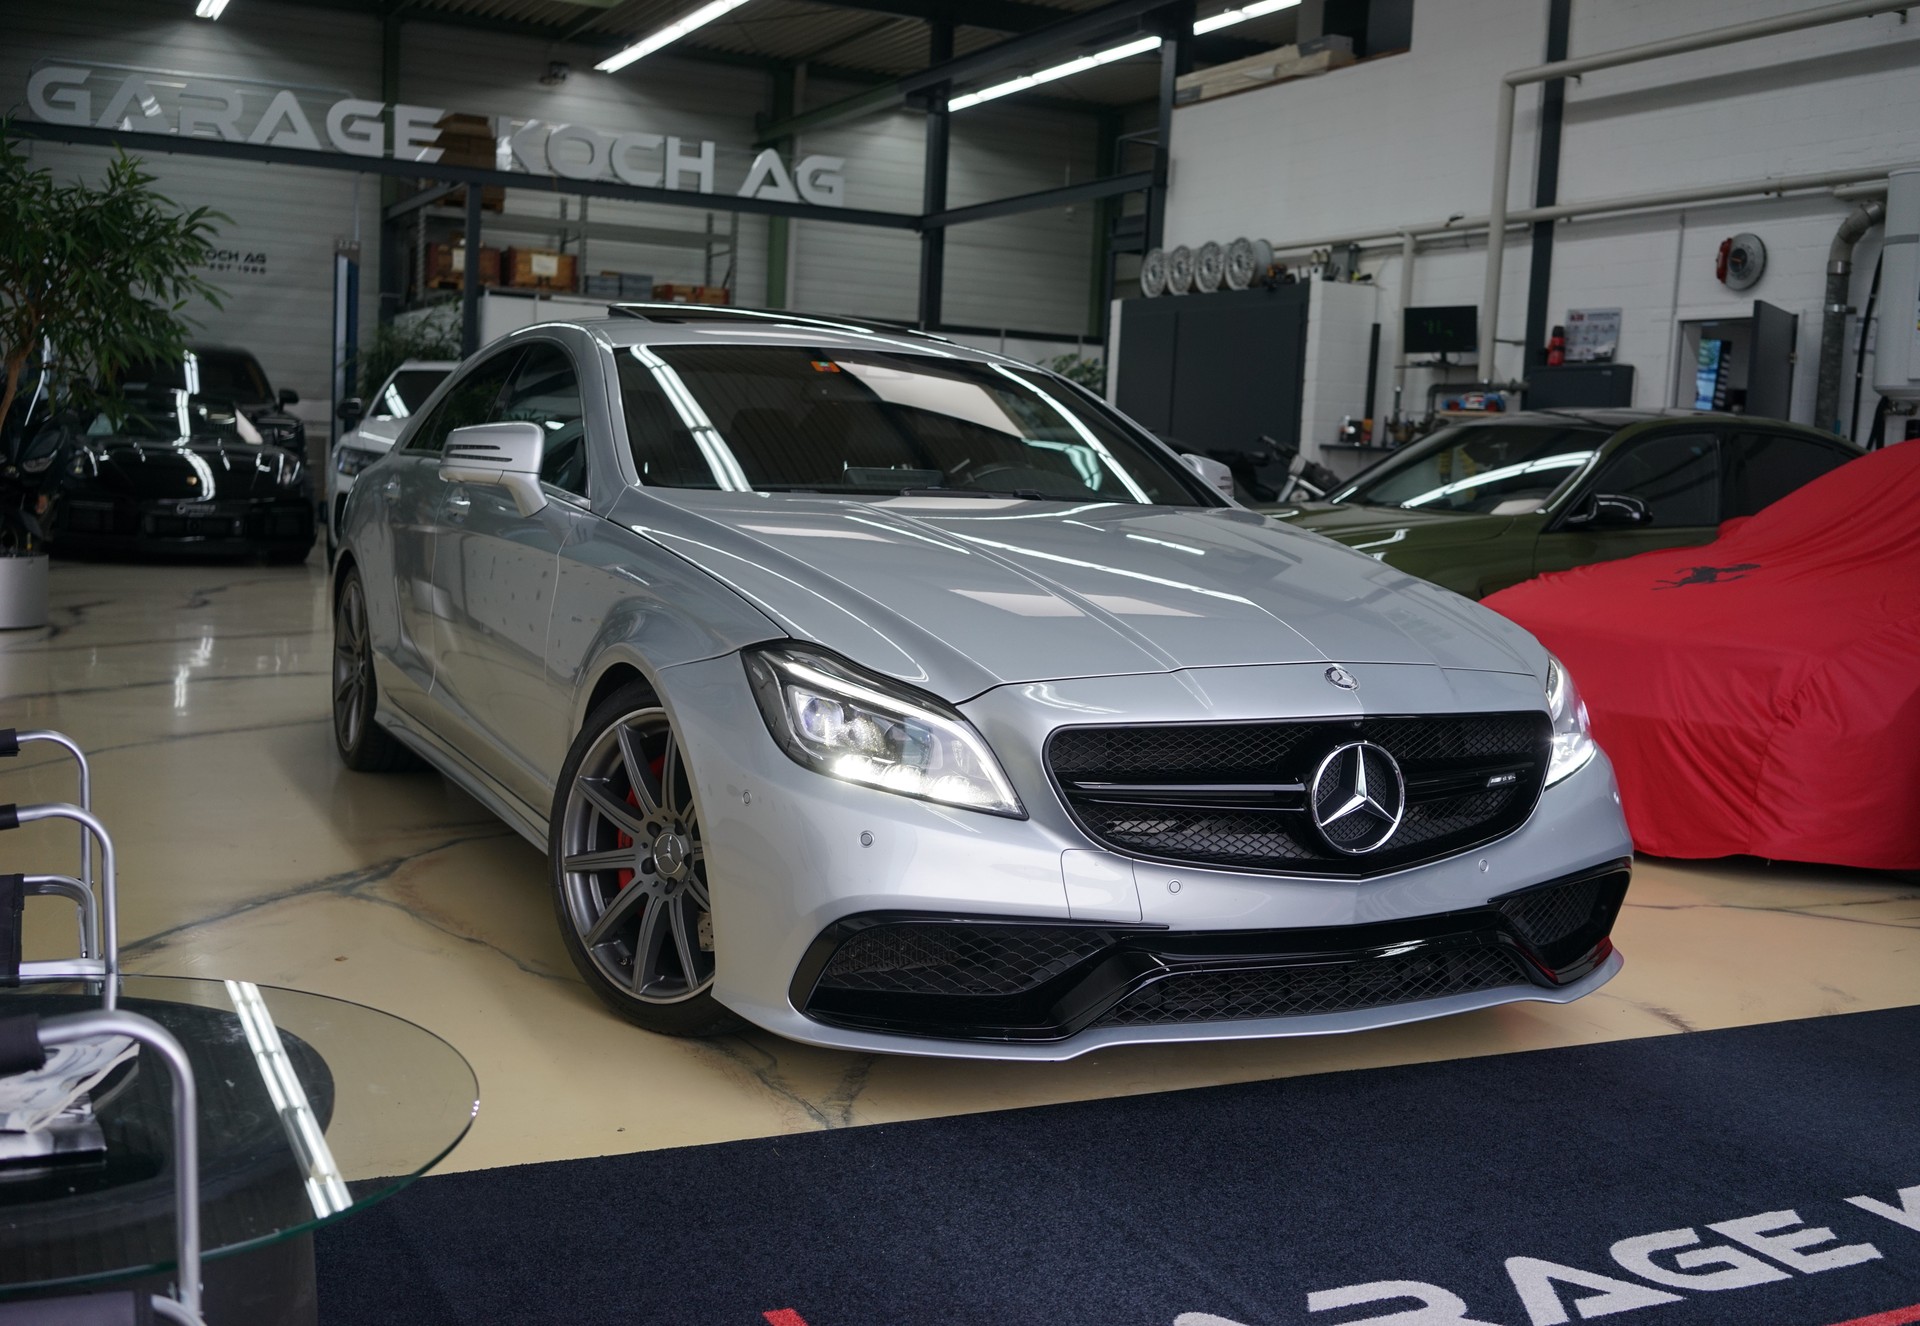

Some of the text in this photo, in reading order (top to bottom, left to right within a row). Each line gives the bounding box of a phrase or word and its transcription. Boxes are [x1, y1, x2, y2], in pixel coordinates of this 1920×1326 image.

[27, 66, 846, 208] GARAGE KOCH AG
[243, 252, 267, 264] AG
